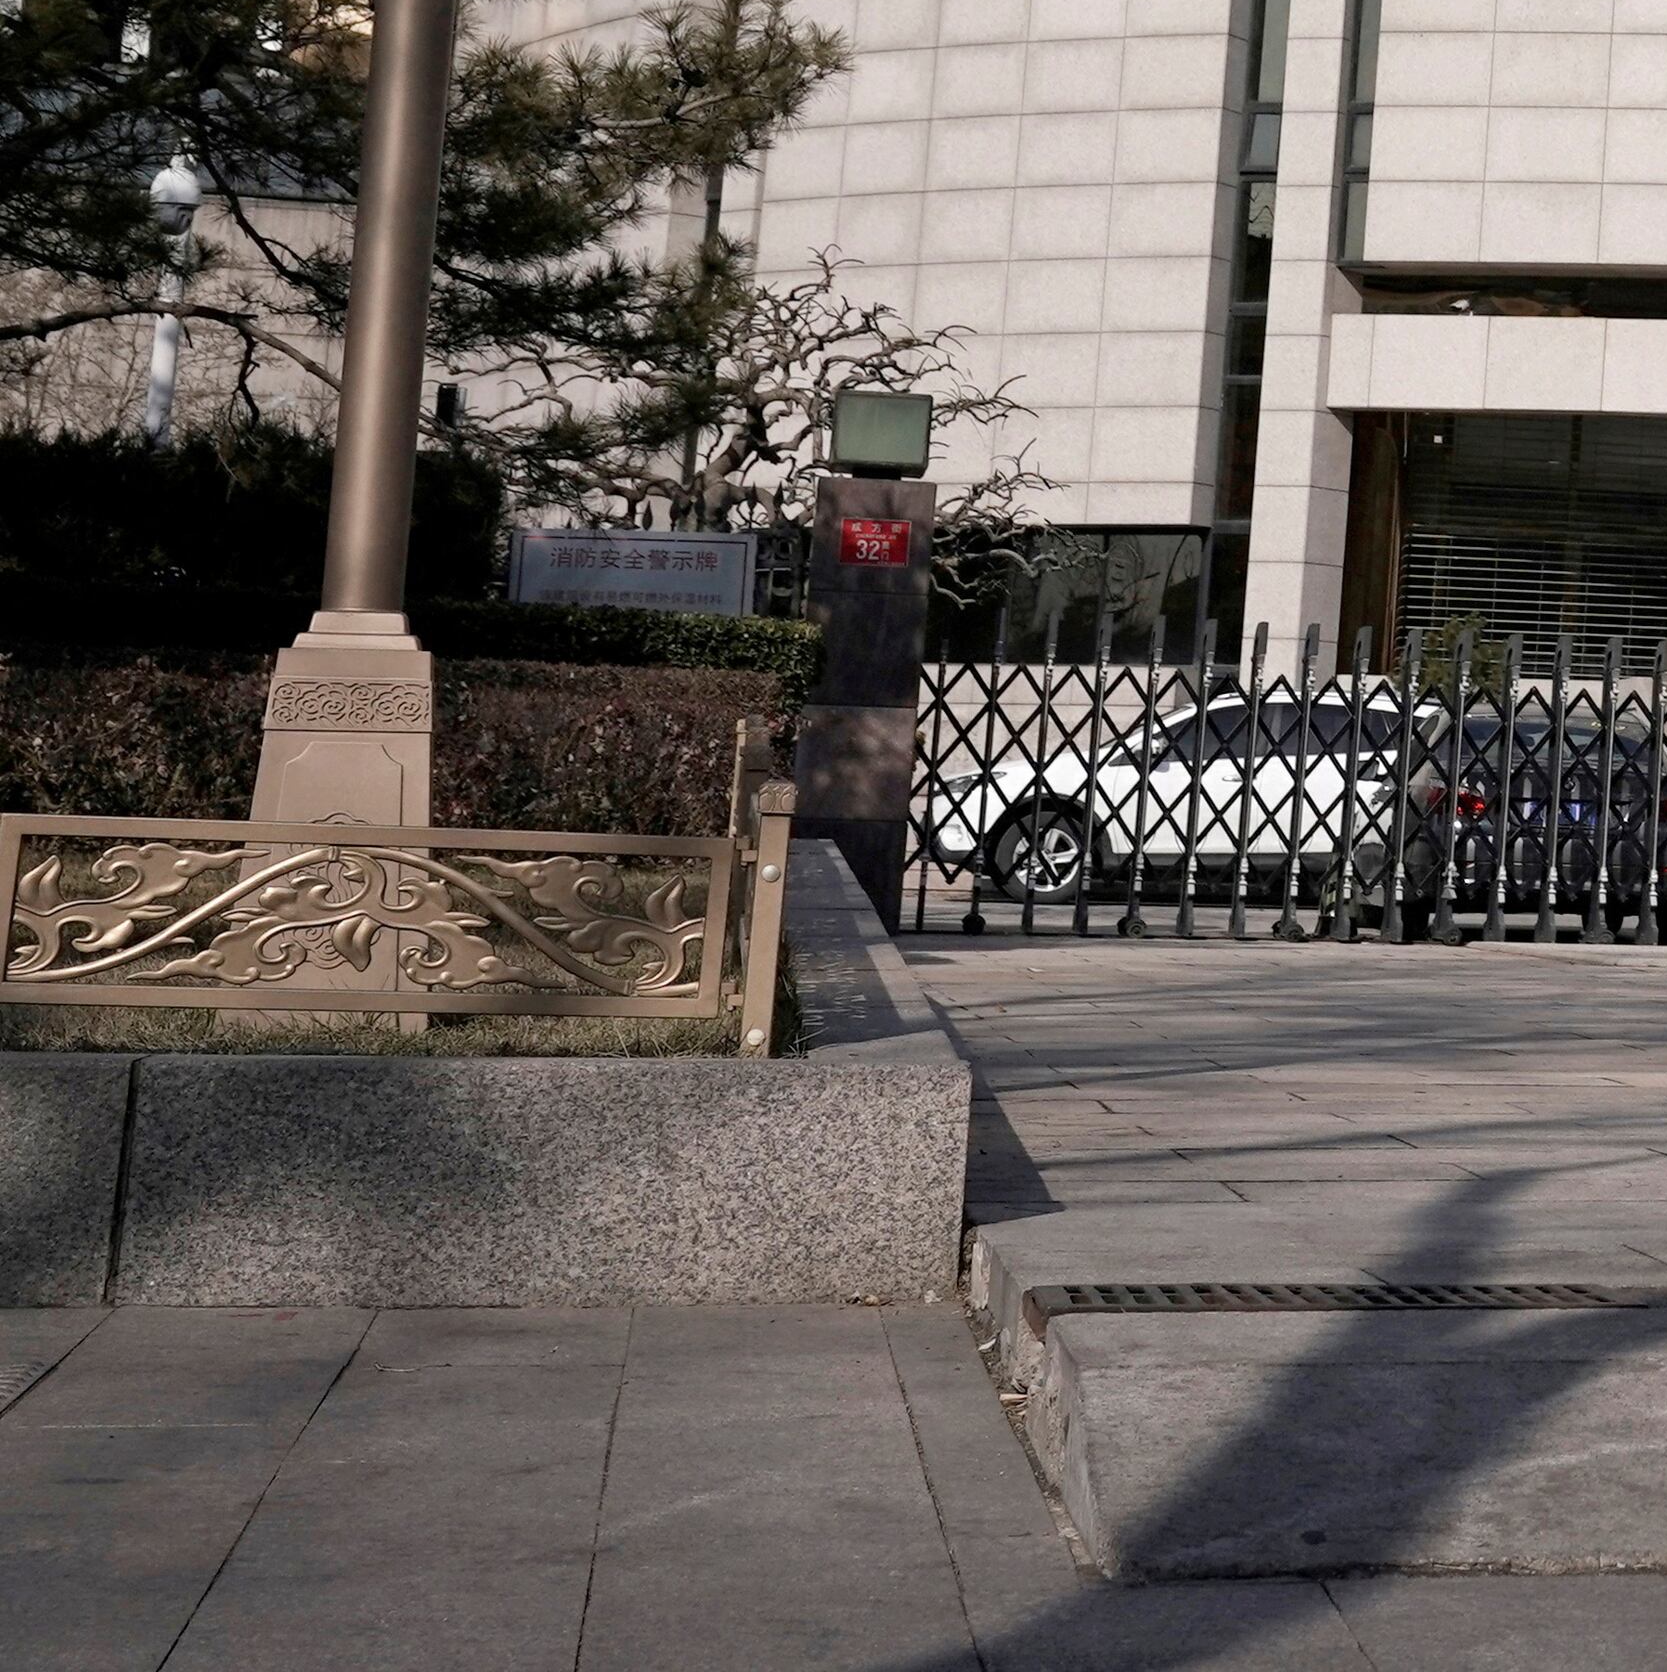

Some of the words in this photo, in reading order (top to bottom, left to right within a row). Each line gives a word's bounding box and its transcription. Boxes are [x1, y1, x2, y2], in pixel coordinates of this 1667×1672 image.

[550, 547, 719, 572] 消防安全警示牌
[856, 539, 881, 560] 32
